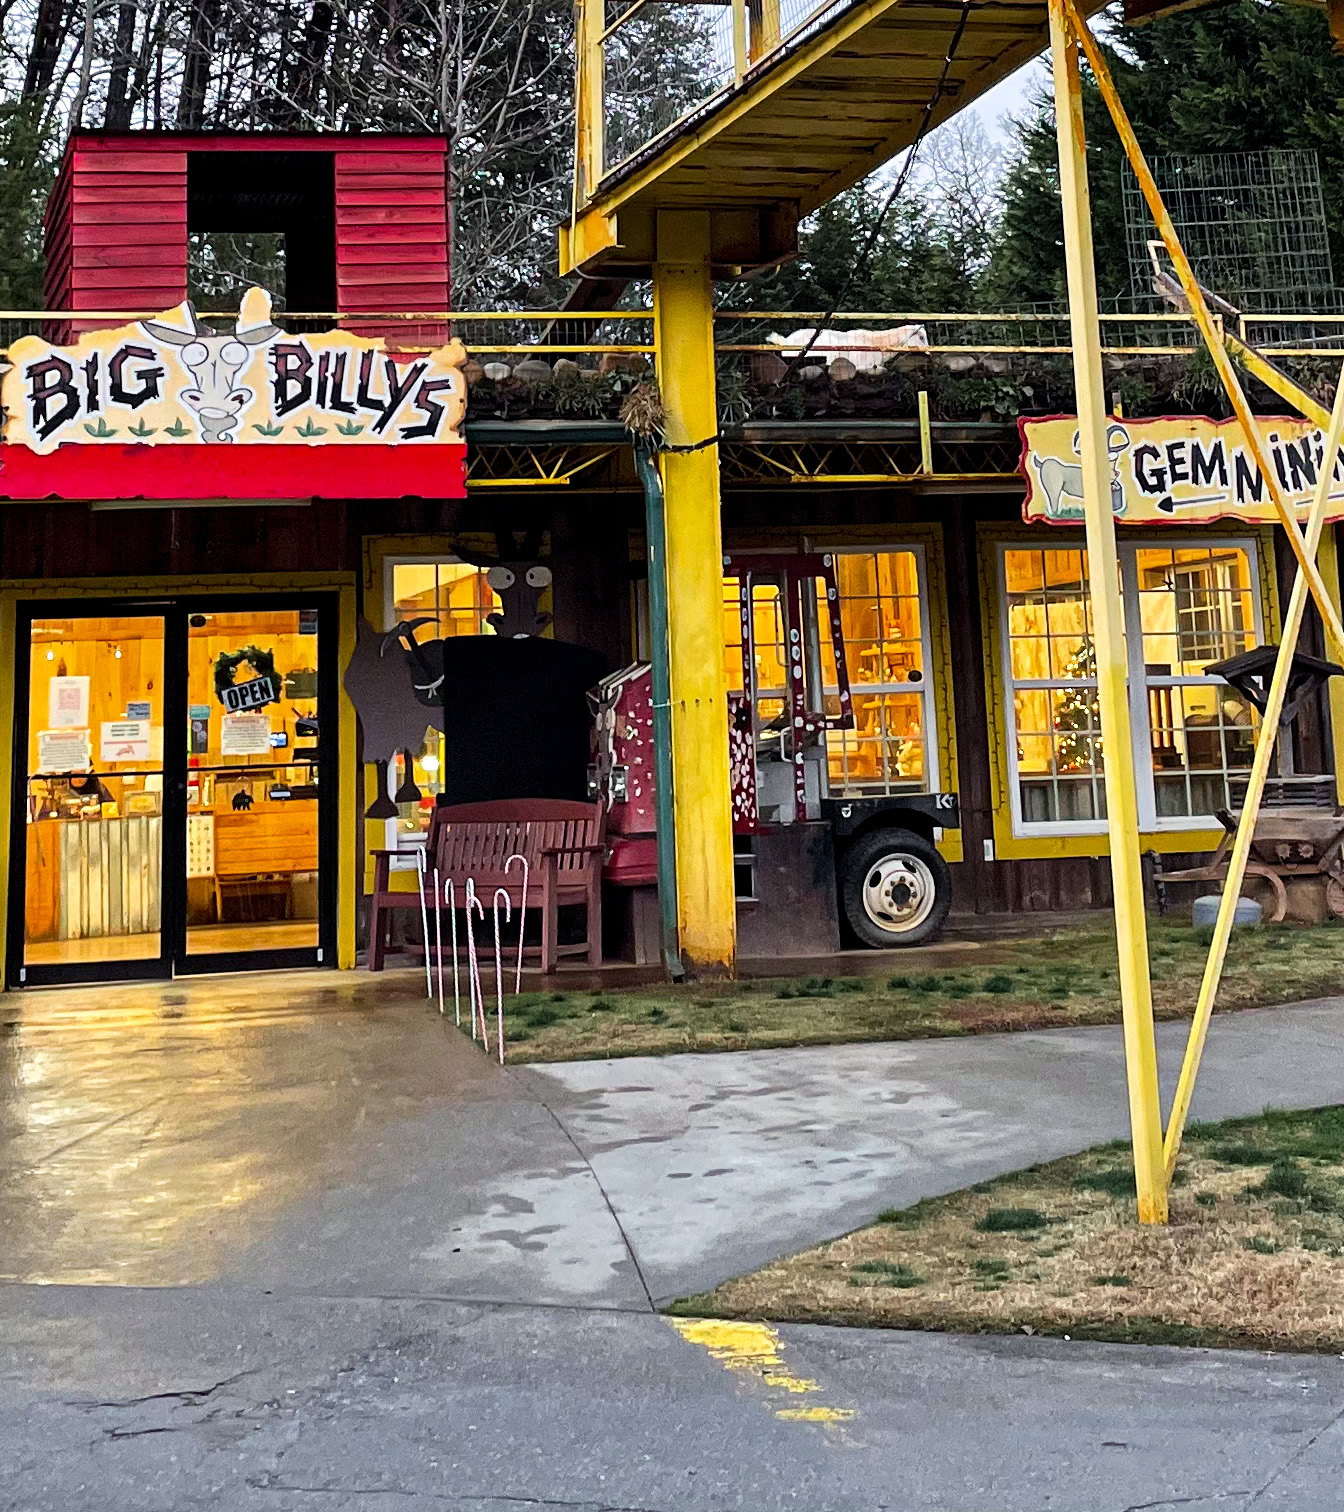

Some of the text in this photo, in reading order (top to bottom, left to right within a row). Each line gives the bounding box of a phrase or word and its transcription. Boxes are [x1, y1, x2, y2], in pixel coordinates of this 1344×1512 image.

[25, 342, 451, 441] BIG BILLYS
[1133, 440, 1229, 494] GEM
[226, 679, 272, 709] OPEN
